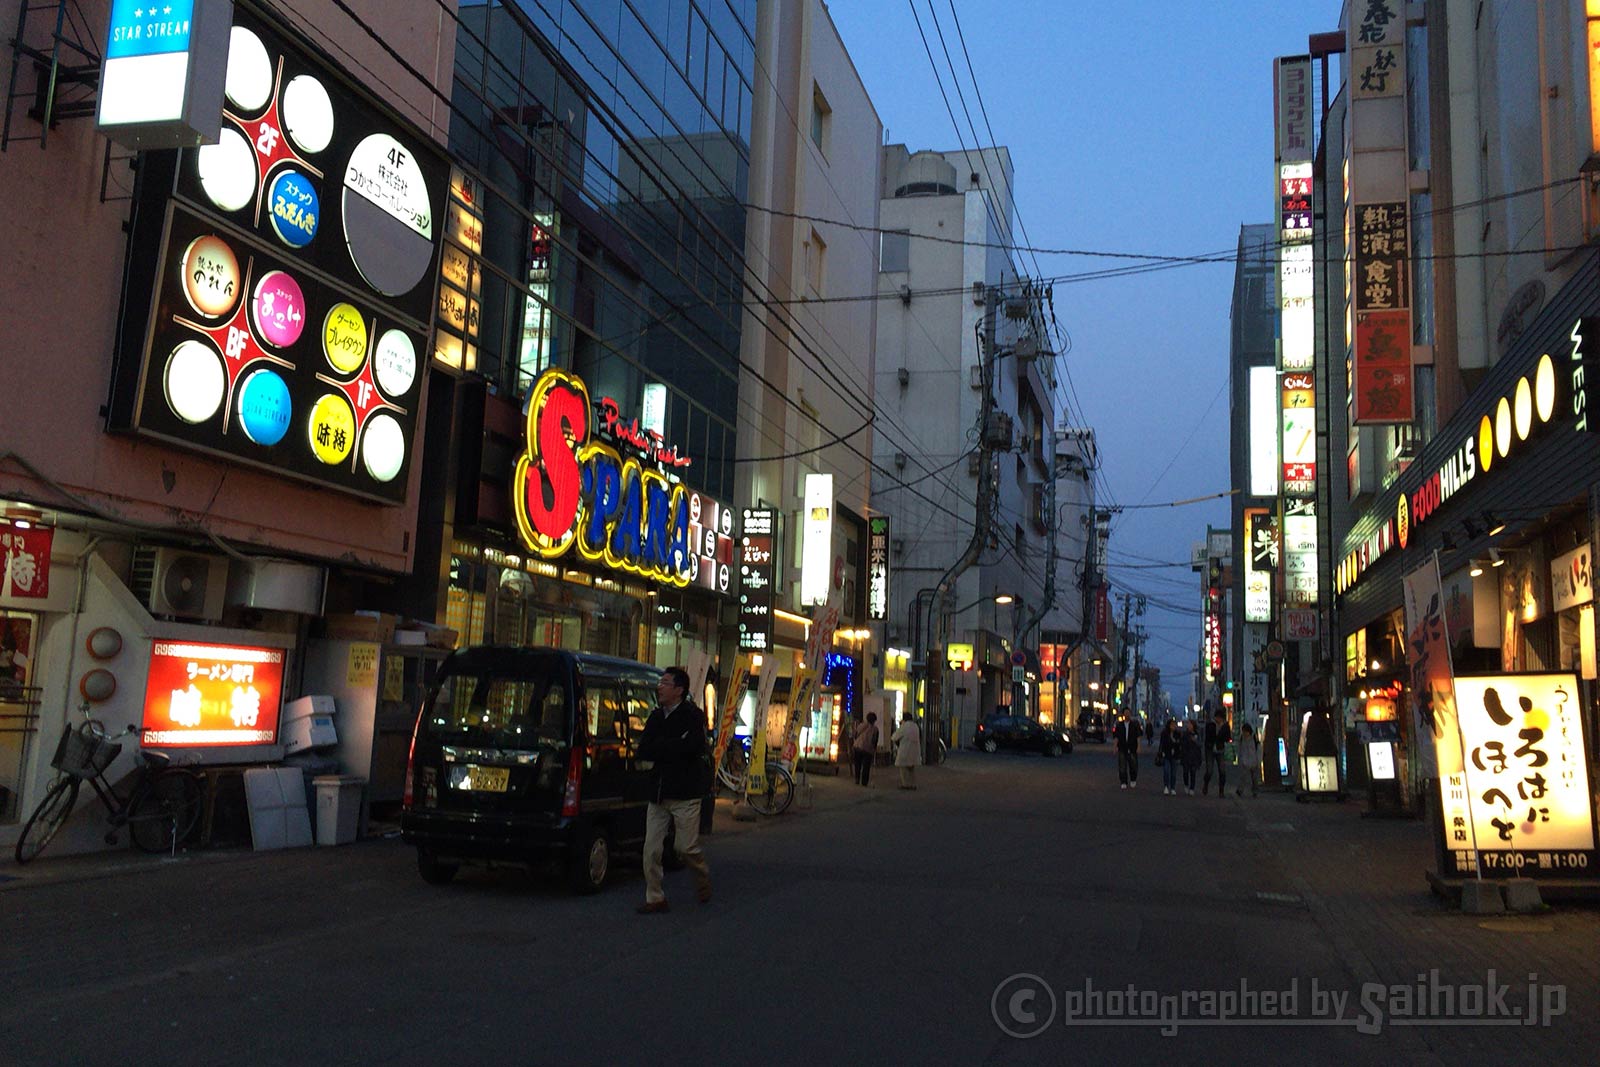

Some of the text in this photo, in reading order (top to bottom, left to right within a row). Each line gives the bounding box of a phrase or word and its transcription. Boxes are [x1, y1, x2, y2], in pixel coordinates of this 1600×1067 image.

[114, 20, 190, 42] STAR STREAM
[256, 121, 280, 158] 2F
[387, 147, 406, 169] 4F
[284, 180, 313, 206] スナック
[378, 163, 409, 198] 株式会社
[350, 166, 431, 231] つかさコーポレーション
[193, 269, 234, 298] のれん
[225, 325, 250, 361] BF
[328, 326, 365, 356] プレイタウン
[1570, 317, 1588, 433] WEST
[356, 379, 374, 411] 1F
[186, 661, 254, 684] ラーメン専門
[1449, 775, 1468, 842] 旭川条店
